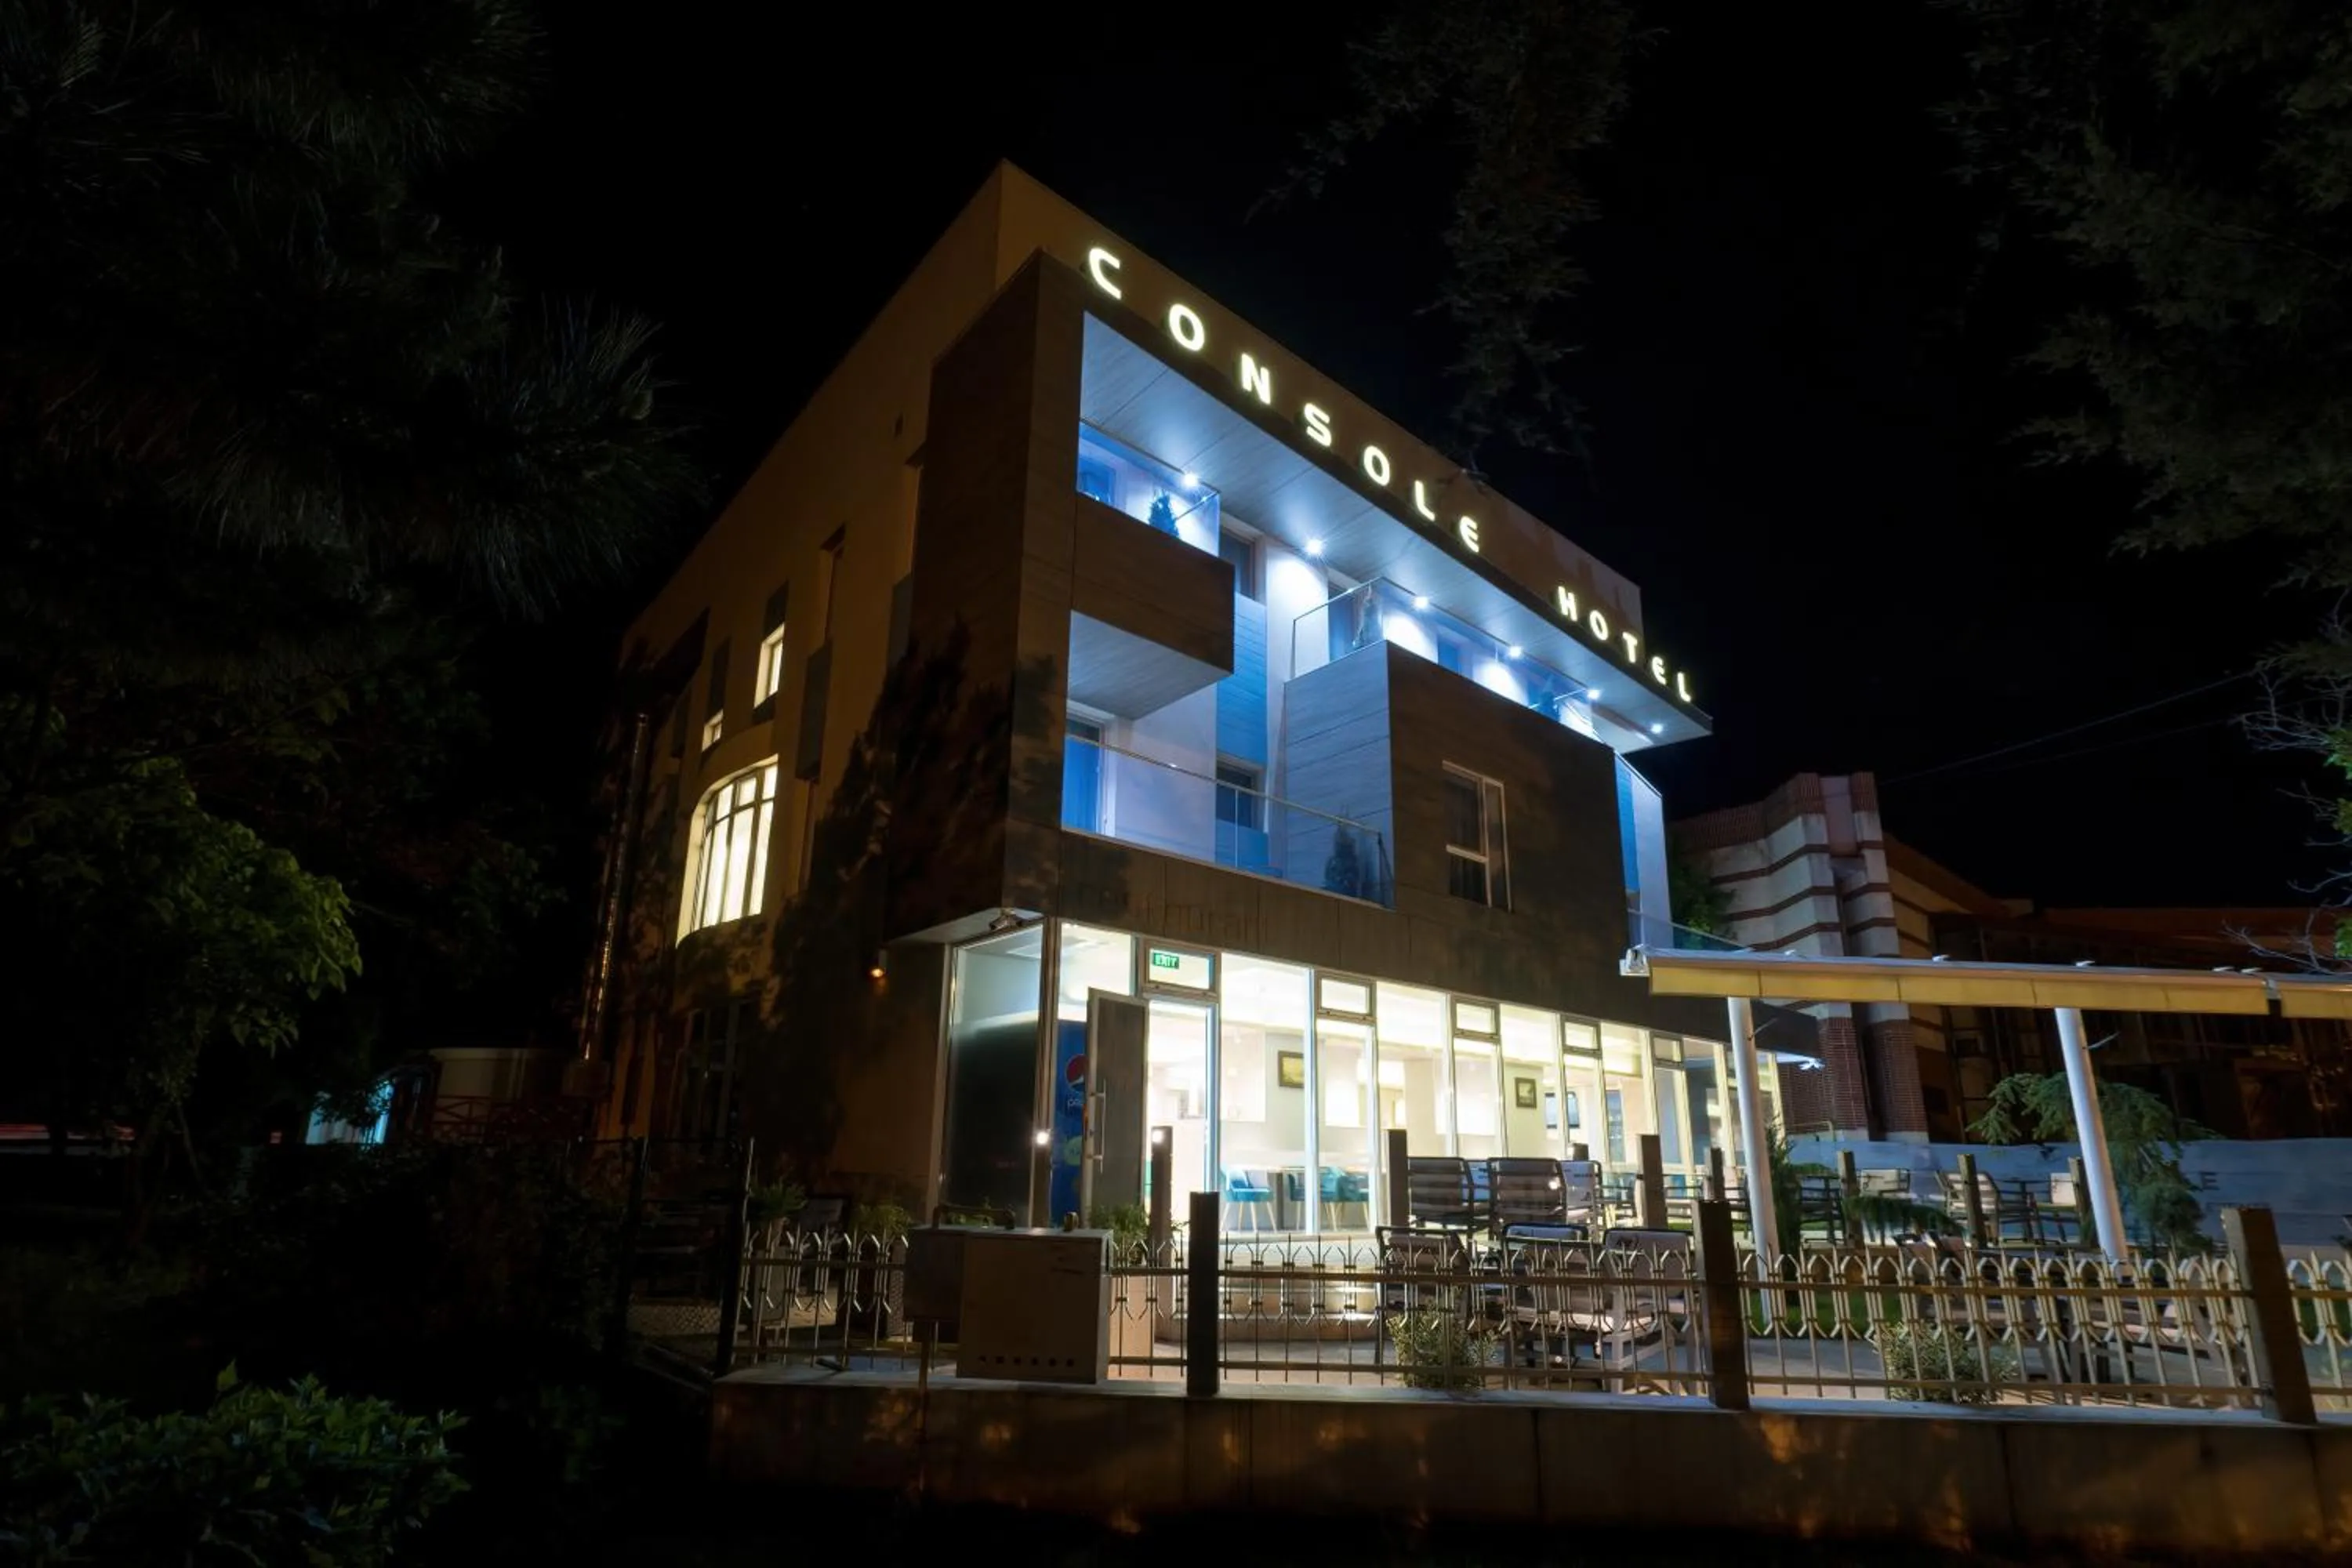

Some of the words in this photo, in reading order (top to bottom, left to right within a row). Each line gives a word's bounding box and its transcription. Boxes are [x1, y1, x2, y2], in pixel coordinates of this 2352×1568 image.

[1088, 247, 1480, 553] CONSOLE
[1557, 586, 1692, 702] HOTEL
[1155, 953, 1178, 967] EXIT
